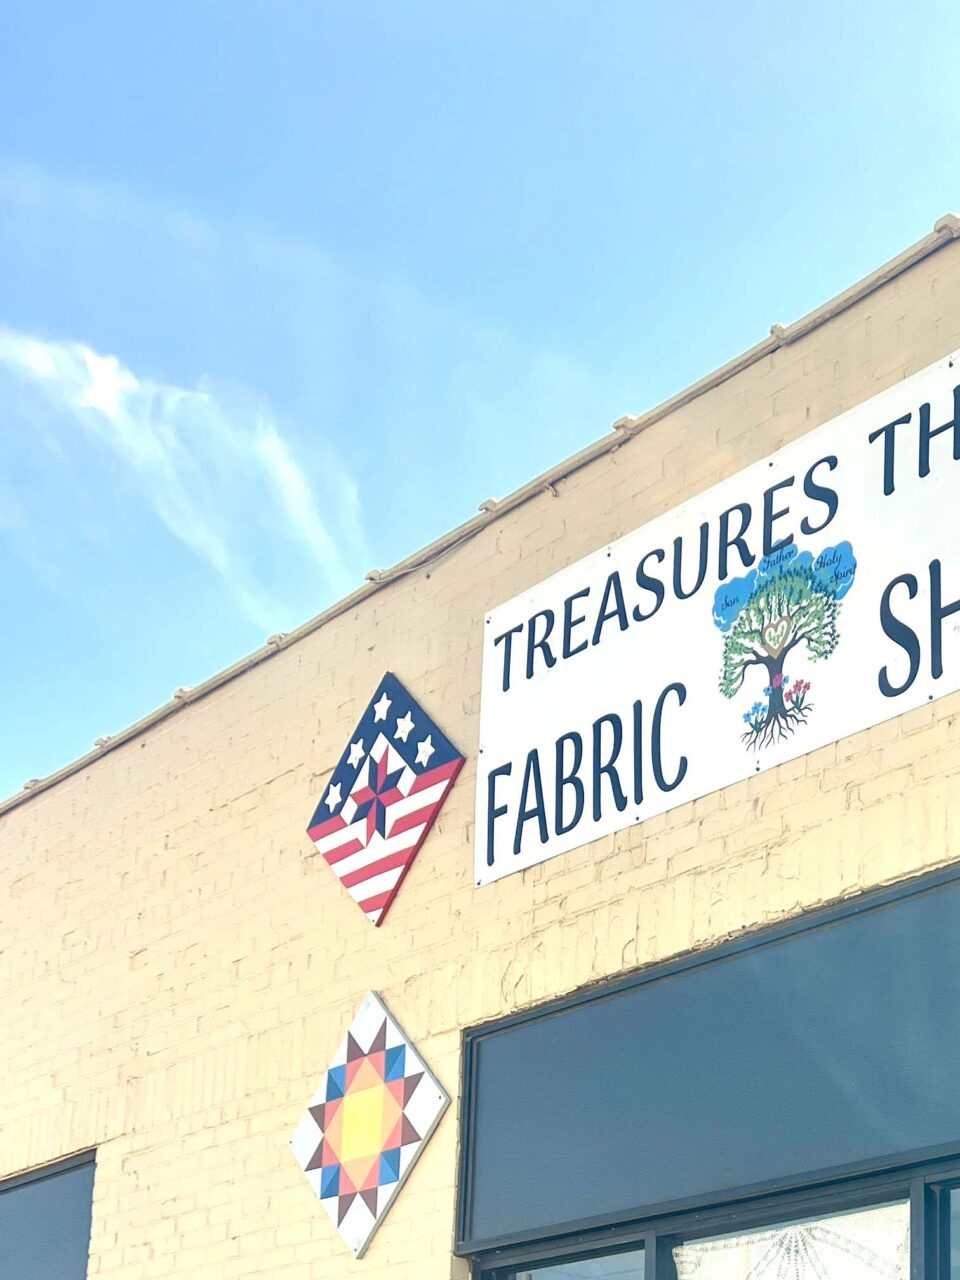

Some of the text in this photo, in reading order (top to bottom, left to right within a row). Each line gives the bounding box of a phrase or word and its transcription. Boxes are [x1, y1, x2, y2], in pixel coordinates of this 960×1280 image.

[494, 455, 839, 692] TREASURES
[762, 548, 795, 572] Father
[814, 549, 843, 572] Holy
[485, 682, 688, 867] FABRIC
